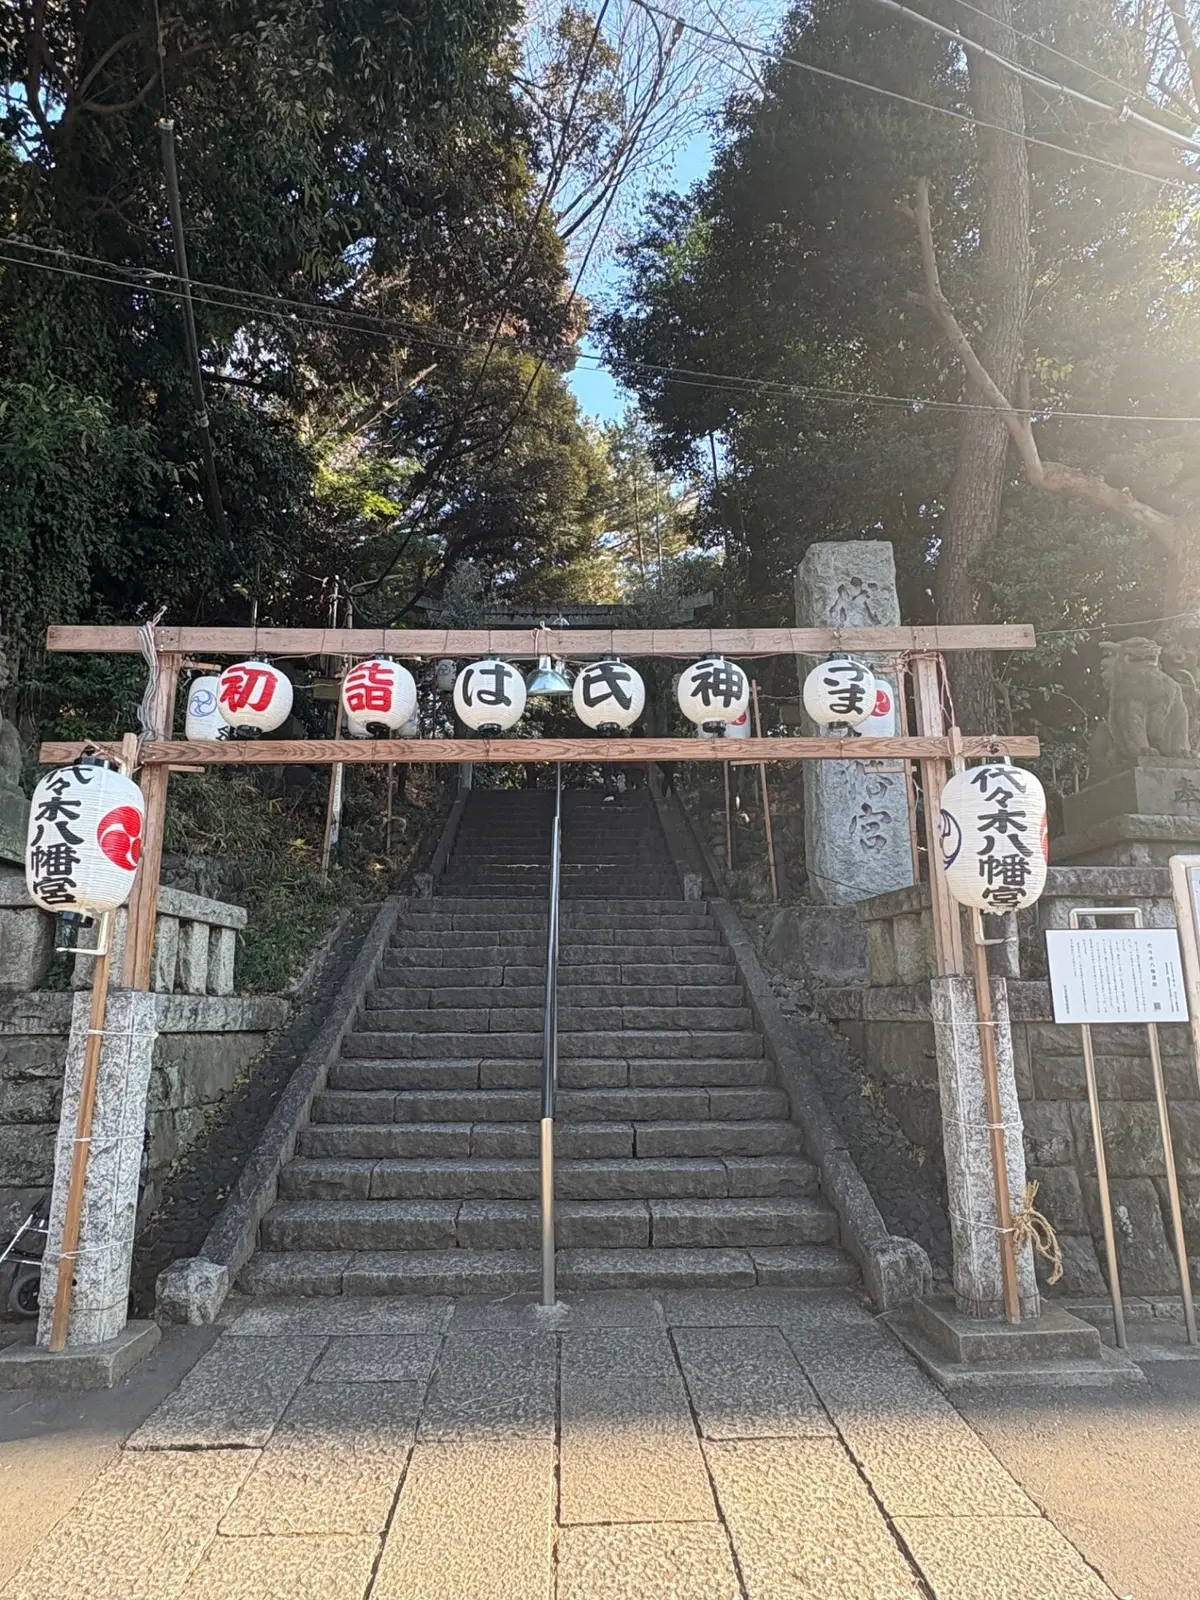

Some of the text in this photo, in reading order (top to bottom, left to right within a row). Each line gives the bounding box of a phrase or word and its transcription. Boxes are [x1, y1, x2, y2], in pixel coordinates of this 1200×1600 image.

[219, 666, 278, 713] 初
[344, 662, 395, 713] 詣
[462, 663, 513, 707] は
[581, 662, 633, 711] 氏
[690, 662, 744, 708] 神
[823, 661, 870, 716] さま
[30, 766, 95, 905] 代々木八幡宮
[970, 767, 1034, 907] 代々木八幡宮
